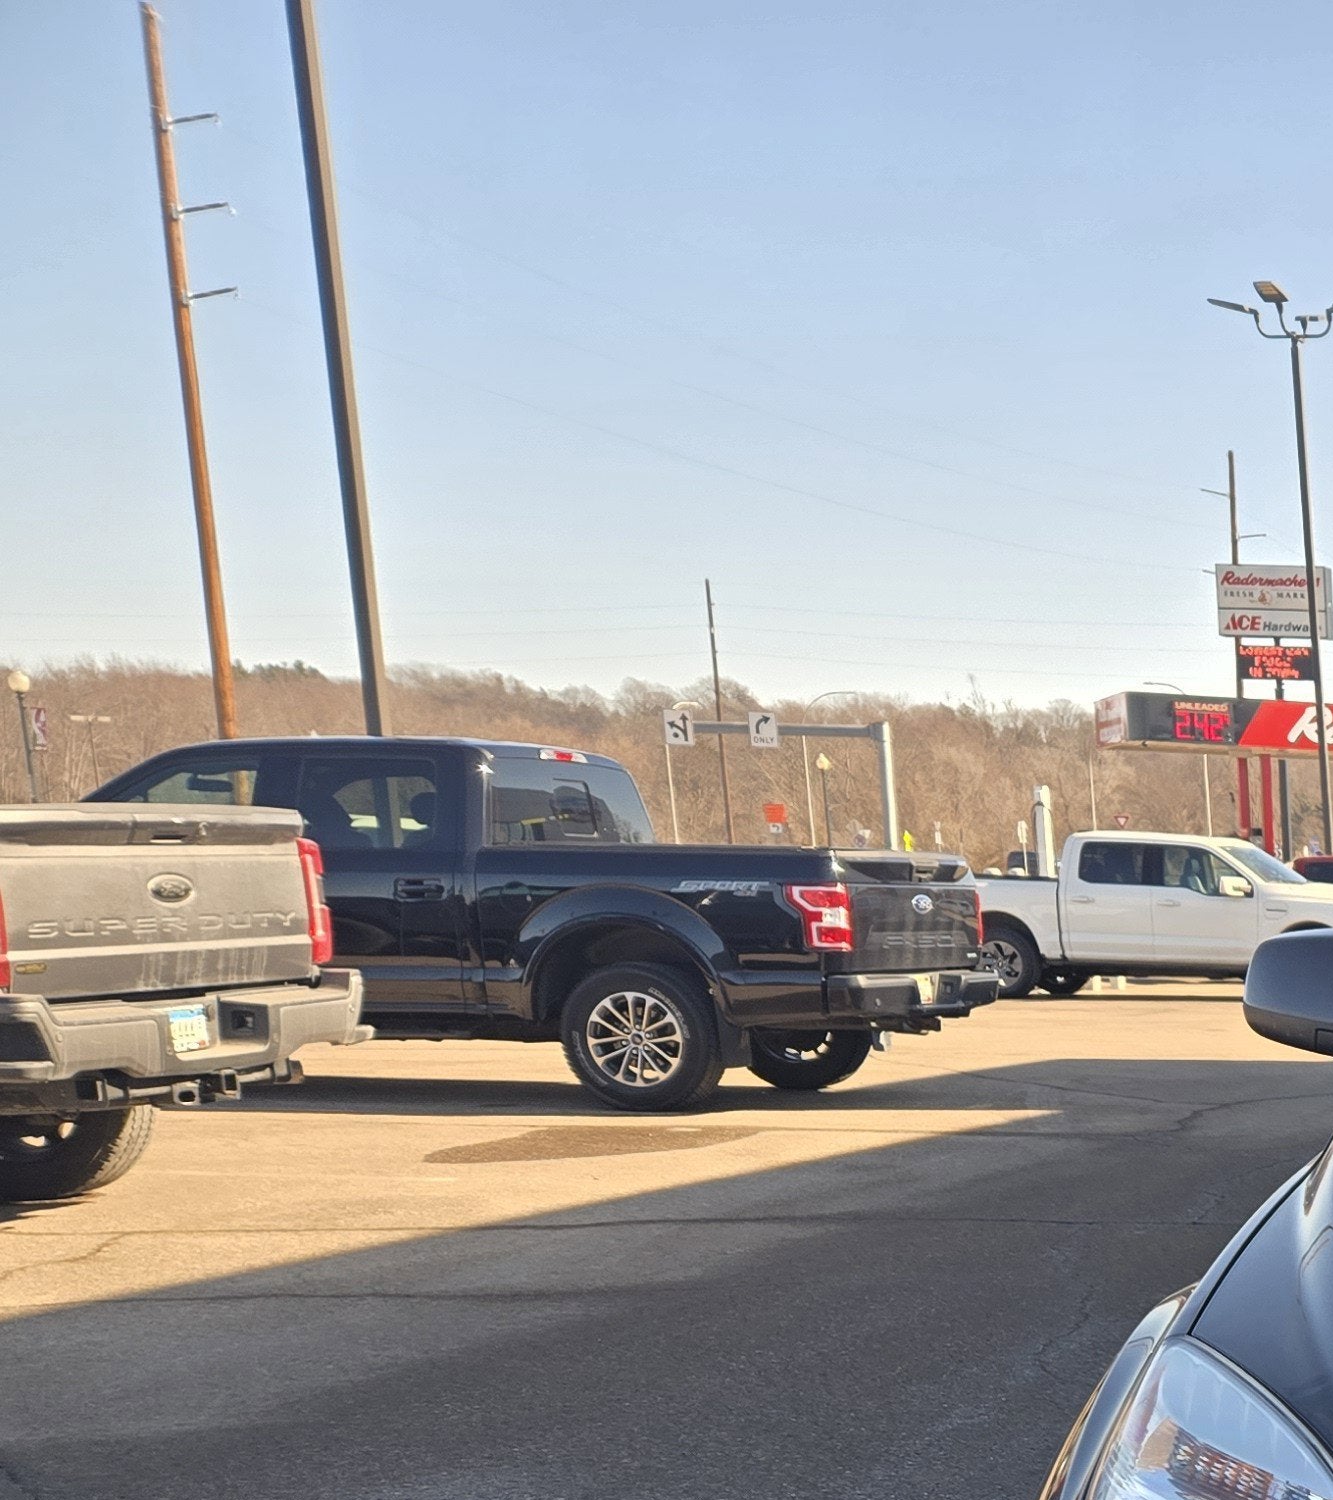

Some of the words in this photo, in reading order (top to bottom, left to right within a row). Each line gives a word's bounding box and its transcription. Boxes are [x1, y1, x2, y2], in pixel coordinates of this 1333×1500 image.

[1220, 571, 1320, 588] Radermache
[1224, 590, 1254, 598] FRESH
[1276, 591, 1306, 599] MARK
[1224, 613, 1261, 631] ACE
[1263, 621, 1321, 632] Hardwa
[1174, 701, 1229, 712] UNLEADED
[670, 880, 770, 893] SPORT
[28, 914, 188, 938] SUPER
[200, 910, 297, 931] DUTY
